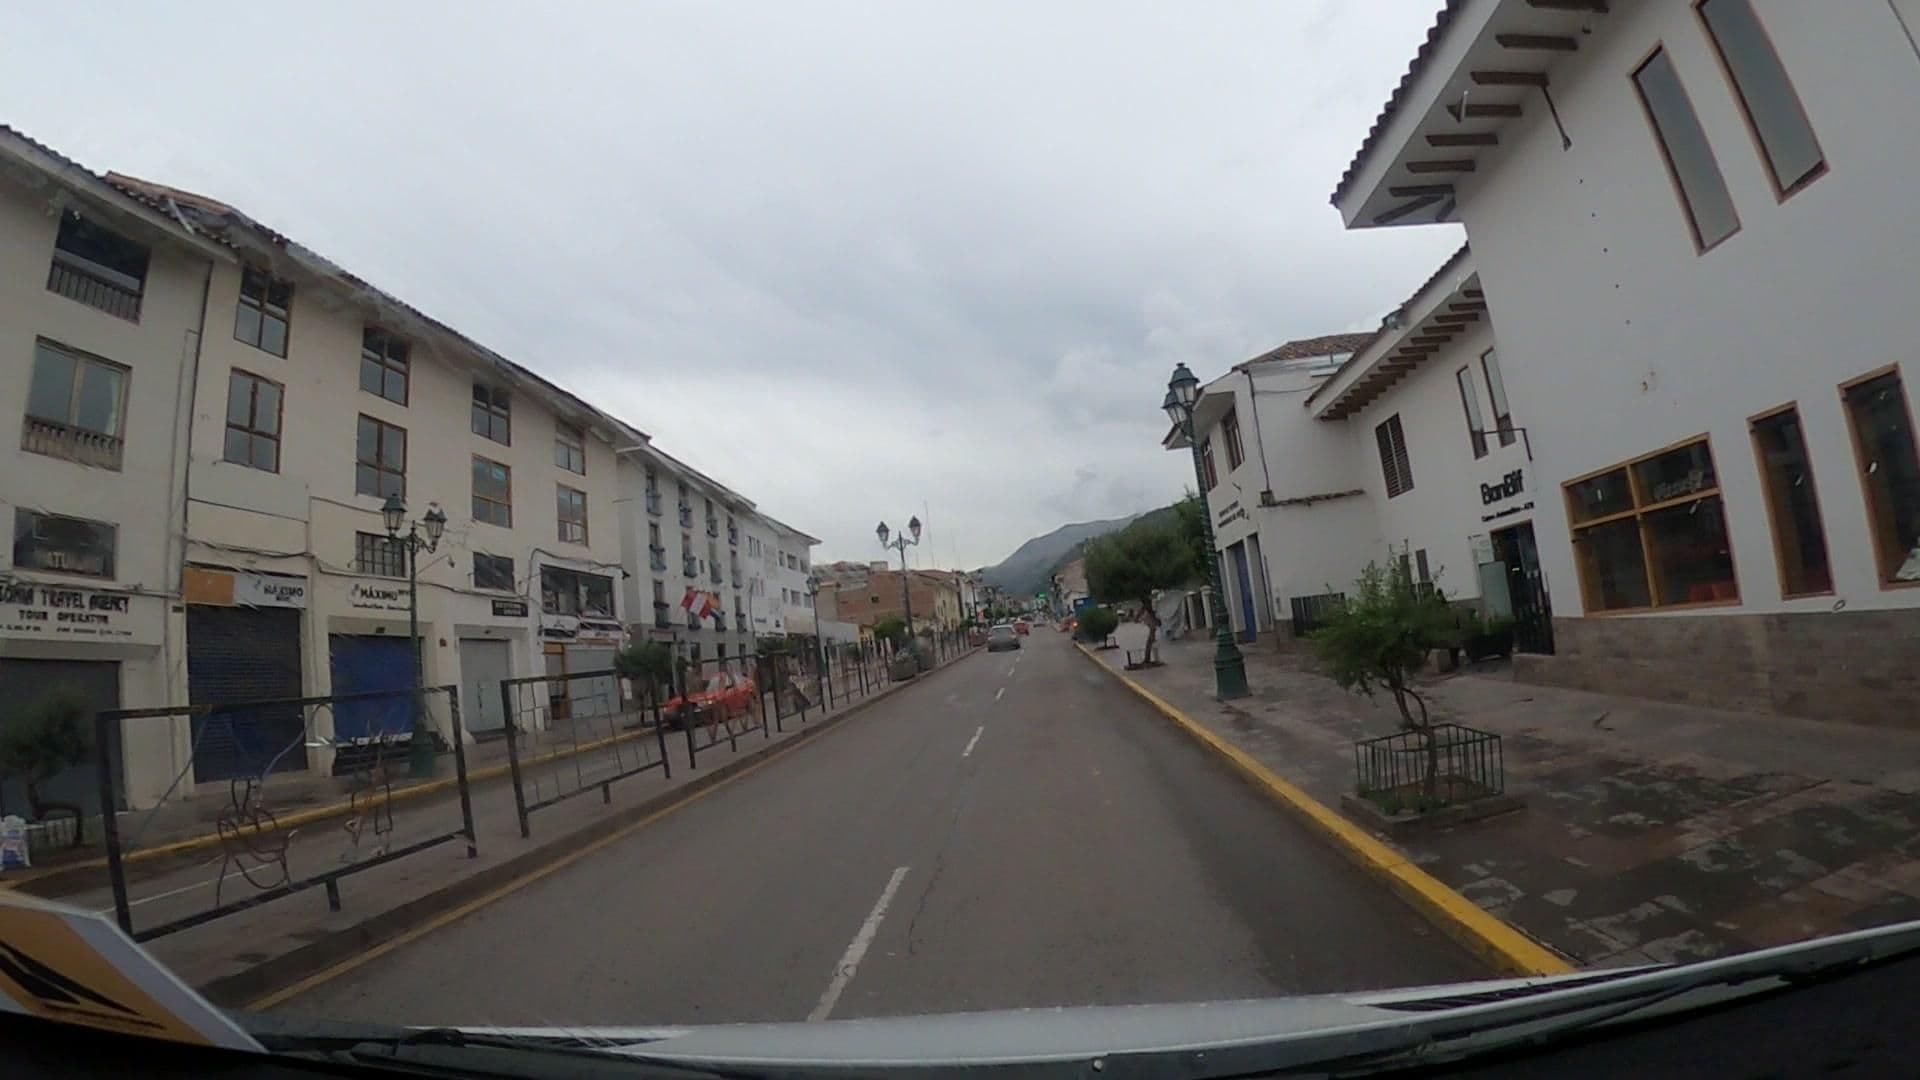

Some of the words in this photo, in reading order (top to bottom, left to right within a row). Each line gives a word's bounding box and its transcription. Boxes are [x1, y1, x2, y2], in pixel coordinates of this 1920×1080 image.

[1480, 468, 1524, 505] BanBif
[41, 589, 85, 609] TRAVEL
[89, 594, 130, 614] AGENCY
[19, 610, 48, 621] TOUR
